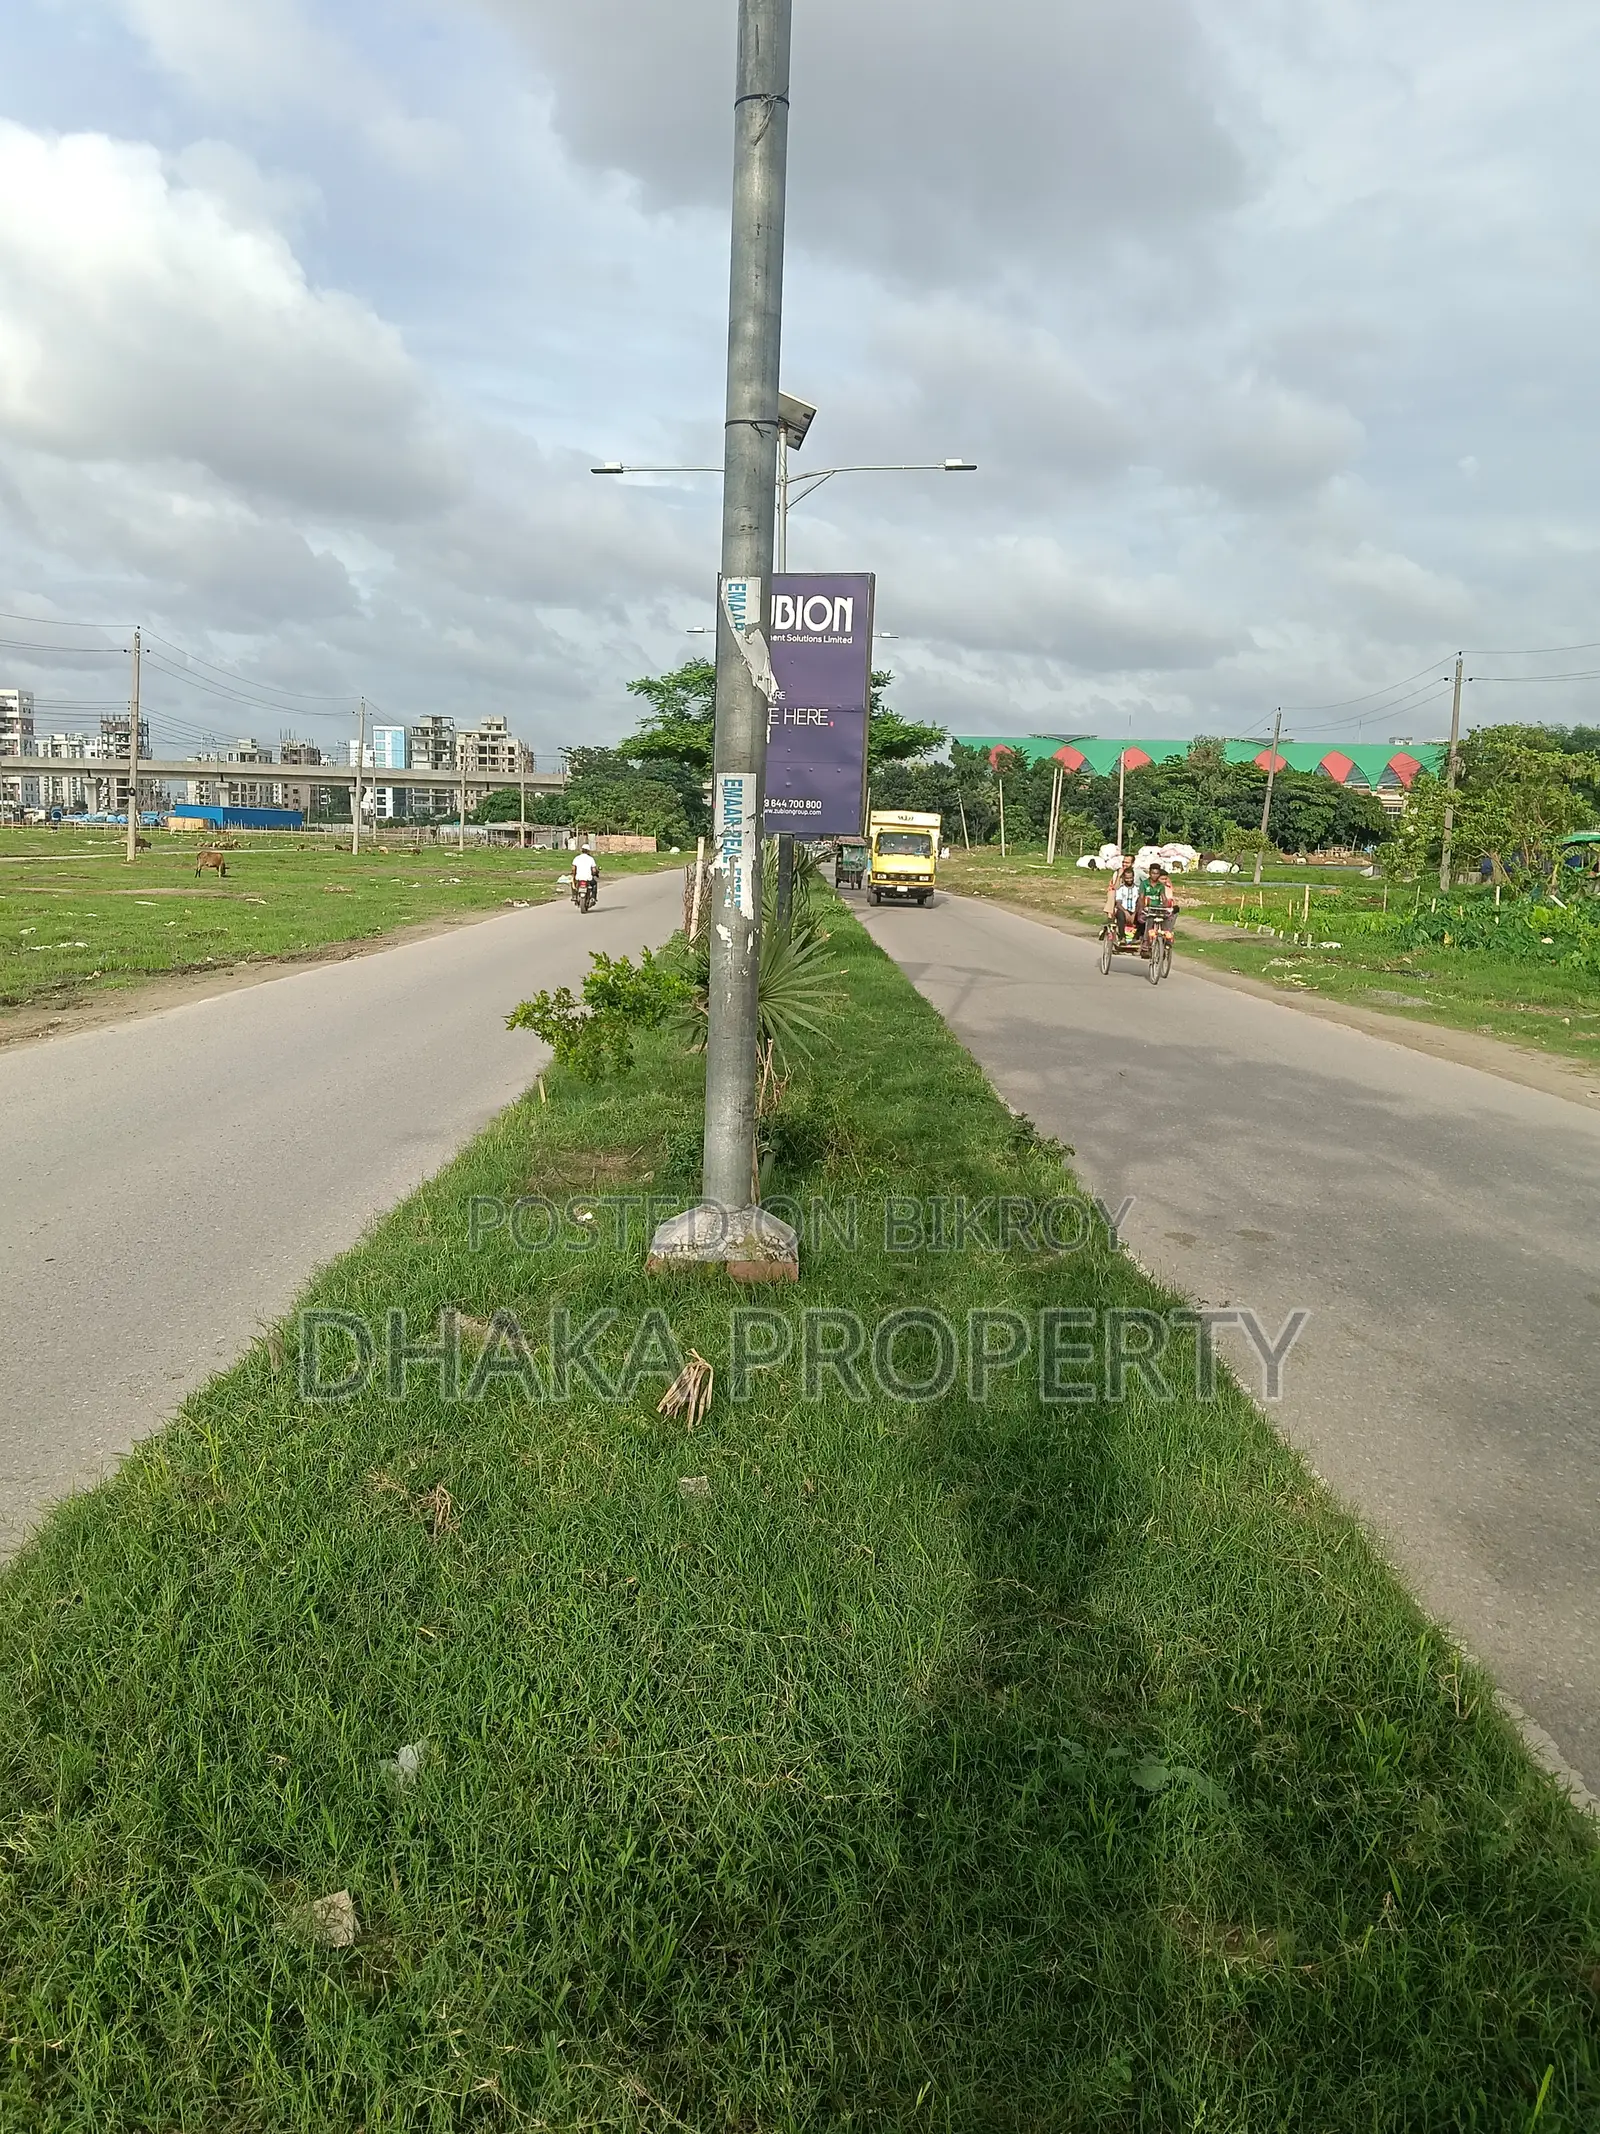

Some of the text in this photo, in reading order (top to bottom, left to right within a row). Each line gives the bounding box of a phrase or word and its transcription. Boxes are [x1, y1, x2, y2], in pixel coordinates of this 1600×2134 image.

[787, 634, 822, 643] Solutions
[823, 636, 853, 644] Limited
[768, 708, 780, 725] E
[724, 779, 742, 825] EMAAR
[771, 799, 787, 808] 644
[789, 800, 804, 809] 700
[806, 800, 822, 809] 800
